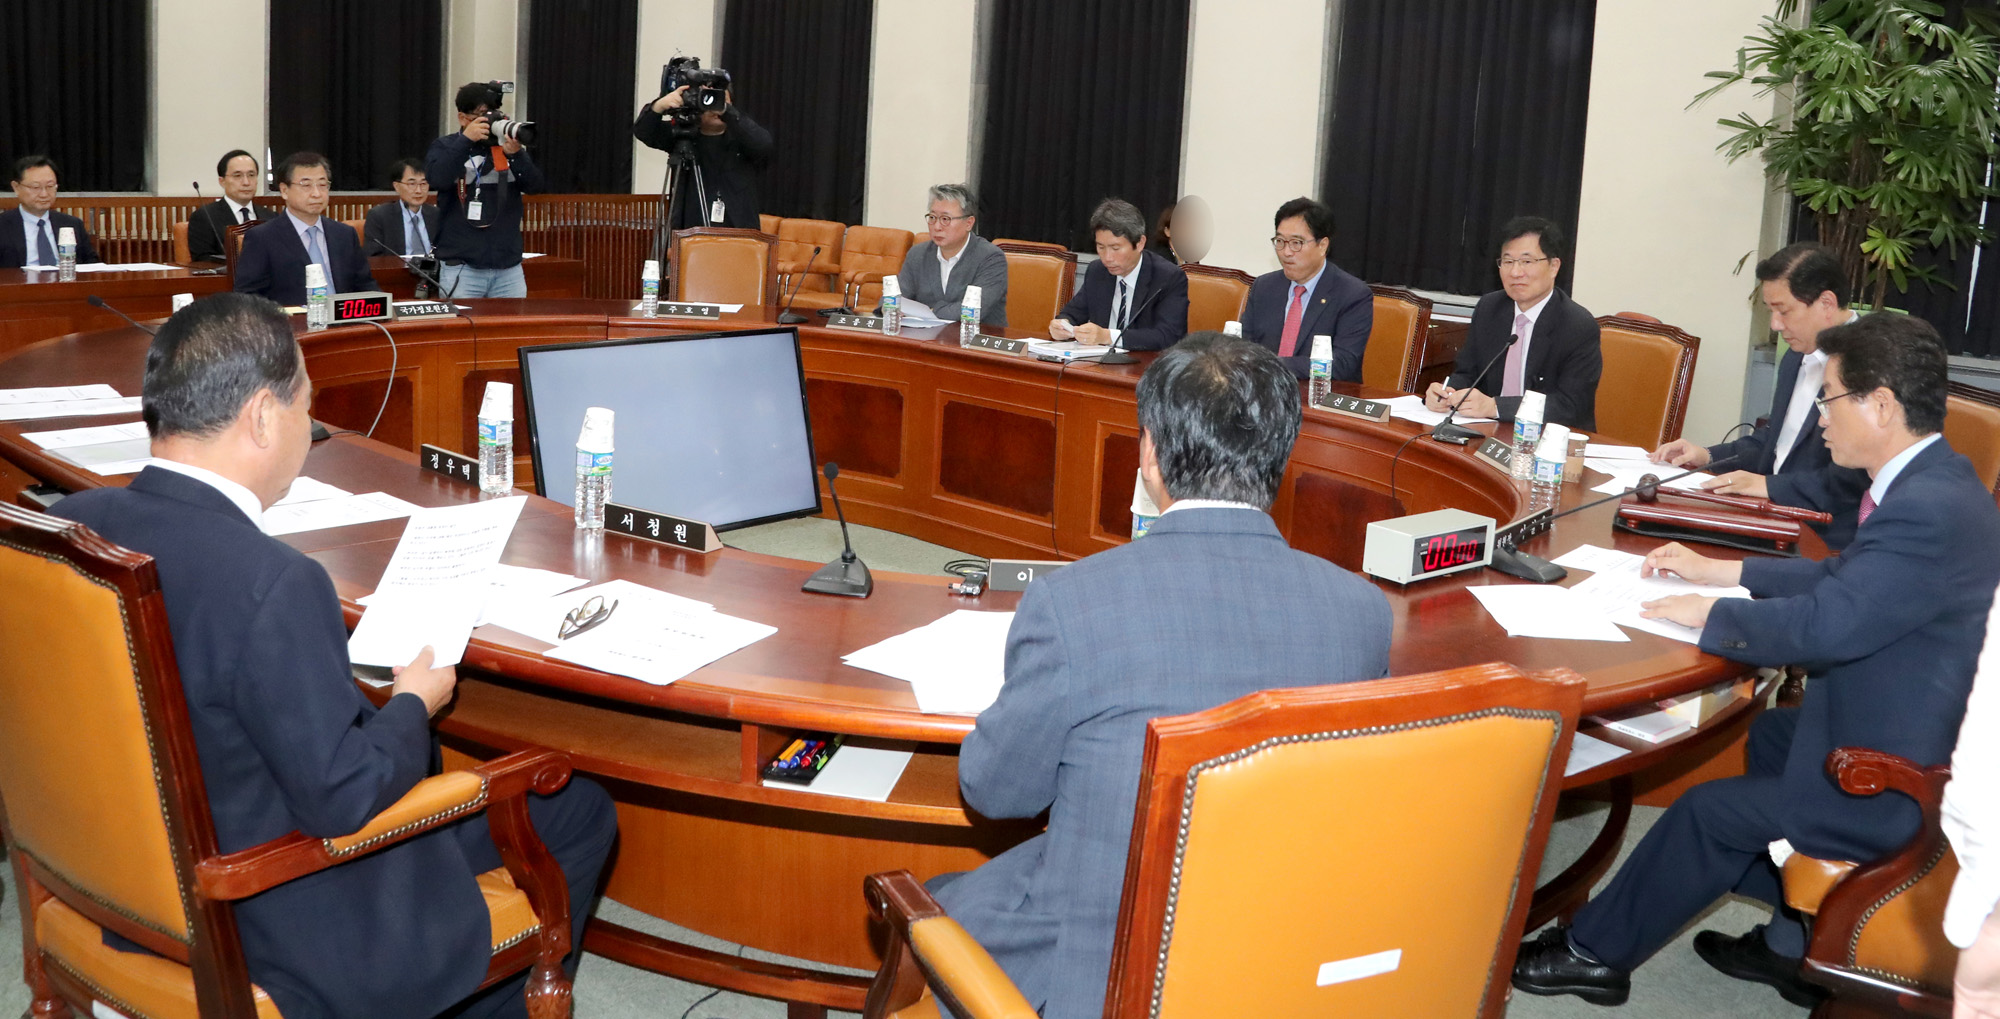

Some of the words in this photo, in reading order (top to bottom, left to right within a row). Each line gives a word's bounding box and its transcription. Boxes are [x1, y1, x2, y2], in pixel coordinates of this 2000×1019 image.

[400, 304, 450, 315] 국가정보원장
[668, 305, 709, 316] 주호영
[838, 317, 875, 328] 조응천
[981, 337, 1016, 351] 이인영
[1333, 397, 1375, 414] 신경민
[430, 453, 471, 481] 정우택
[620, 512, 688, 543] 서청원
